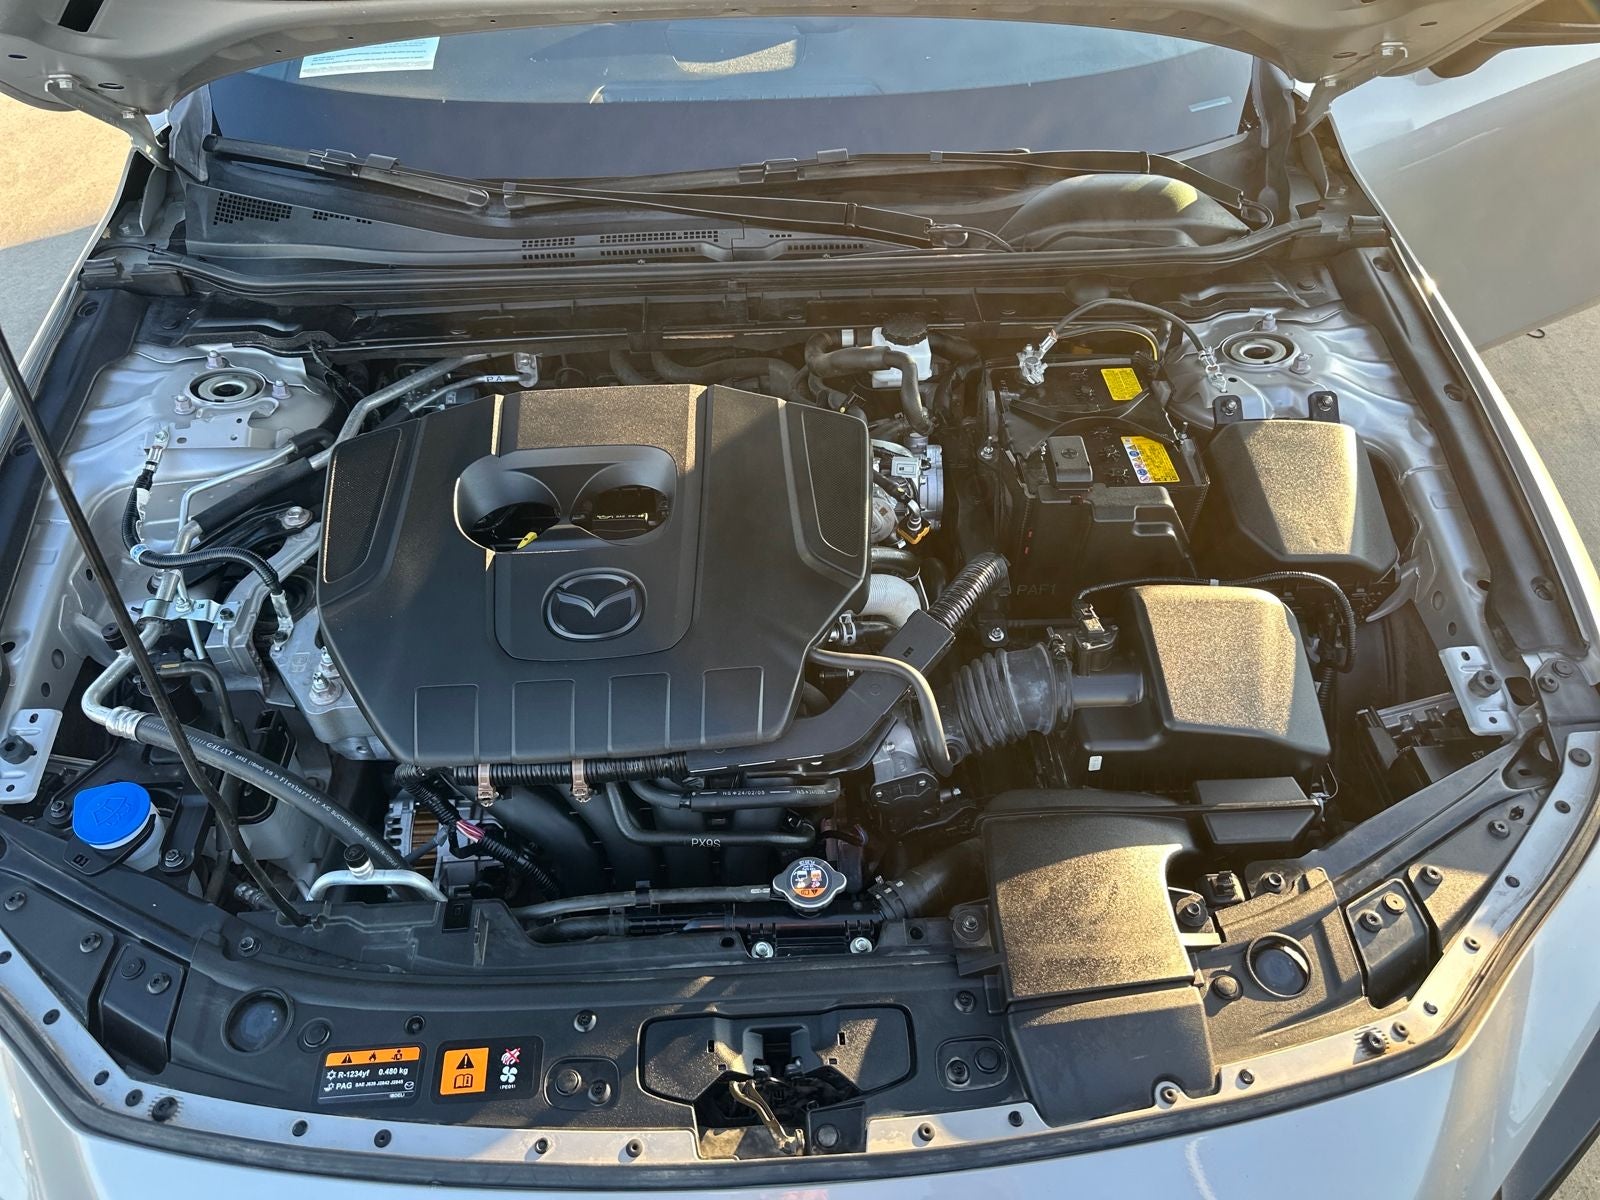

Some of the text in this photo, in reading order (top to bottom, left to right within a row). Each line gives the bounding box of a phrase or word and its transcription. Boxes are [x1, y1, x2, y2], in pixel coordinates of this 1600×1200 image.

[206, 741, 235, 757] GALAXY
[331, 809, 352, 828] SUCTION
[337, 1067, 409, 1079] R-1234yf 0.480 kg
[335, 1082, 353, 1090] PAG
